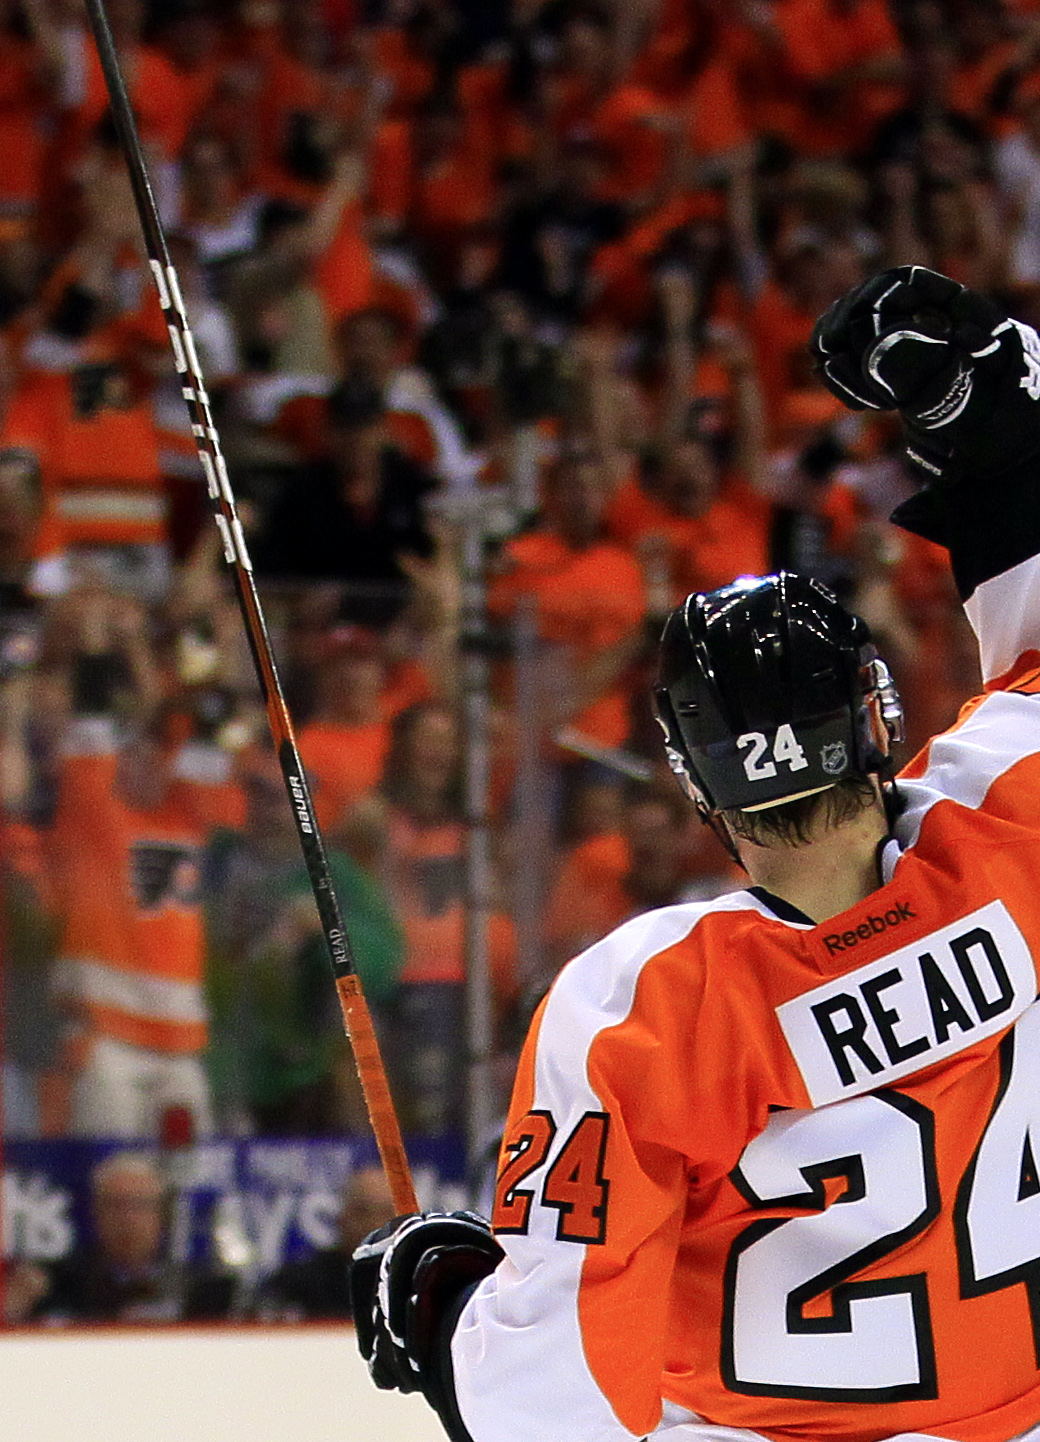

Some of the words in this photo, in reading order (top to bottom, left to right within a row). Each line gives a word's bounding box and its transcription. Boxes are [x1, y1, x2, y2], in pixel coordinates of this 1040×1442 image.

[736, 724, 808, 781] 24
[289, 775, 313, 834] BAUER
[329, 928, 348, 965] READ
[823, 902, 916, 957] Reebok
[810, 927, 1015, 1087] READ
[492, 1110, 610, 1245] 24
